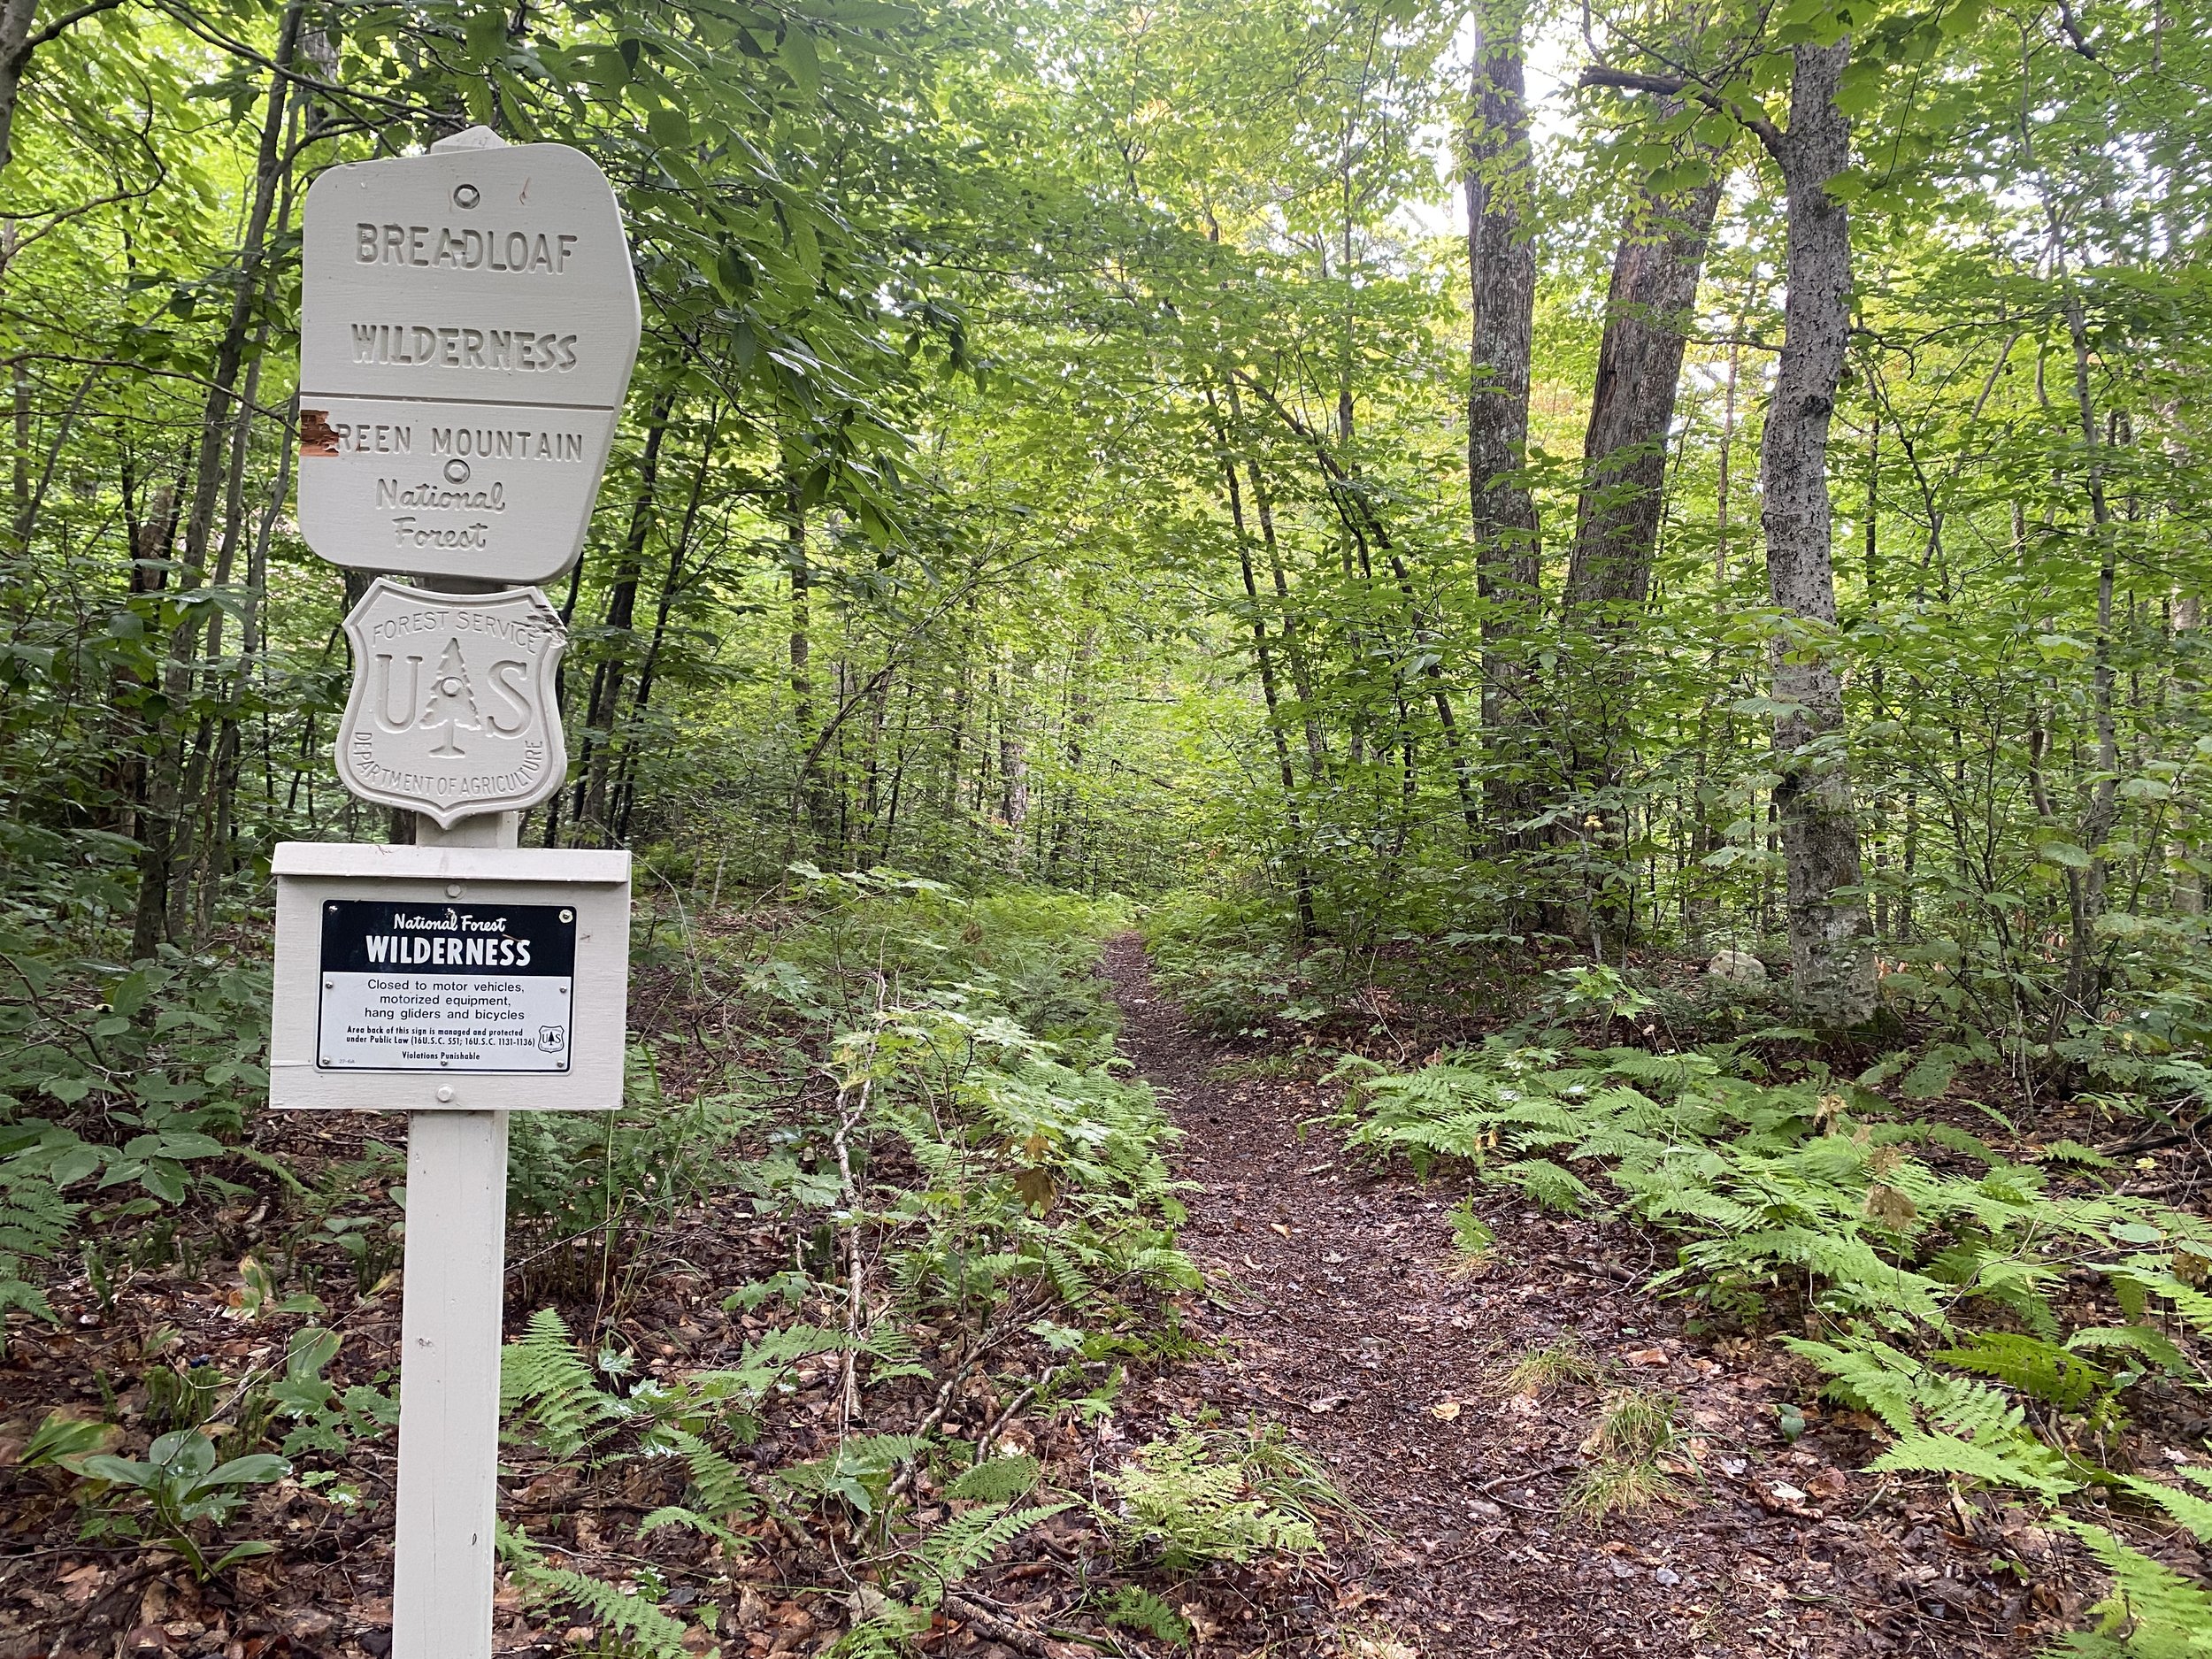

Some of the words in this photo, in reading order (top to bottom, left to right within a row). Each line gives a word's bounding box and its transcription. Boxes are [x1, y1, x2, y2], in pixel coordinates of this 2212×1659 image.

[355, 223, 578, 274] BREADLOAF
[350, 323, 578, 373] WILDERNESS
[324, 423, 411, 454] REEN
[430, 427, 582, 462] MOUNTAIN
[375, 478, 505, 513] National
[391, 516, 488, 550] Forest
[372, 611, 449, 648] FOREST
[456, 611, 540, 655] SERVICE
[354, 732, 434, 796] DEPARTMENT
[437, 777, 456, 796] OF
[461, 741, 542, 796] AGRICULTURE
[394, 913, 458, 931] National
[461, 915, 506, 932] Forest
[366, 935, 531, 966] WILDERNESS
[368, 979, 409, 989] Closed
[415, 980, 426, 990] to
[433, 981, 468, 991] motor
[474, 982, 525, 993] vehicles,
[380, 995, 440, 1004] motorized
[446, 995, 511, 1007] equipment,
[365, 1008, 395, 1019] hang
[401, 1009, 441, 1020] gliders
[447, 1010, 469, 1019] and
[475, 1010, 525, 1021] bicycles
[411, 1027, 426, 1036] sign
[438, 1028, 471, 1037] managed
[489, 1028, 523, 1037] protected
[498, 1038, 535, 1047] 1131-1136)
